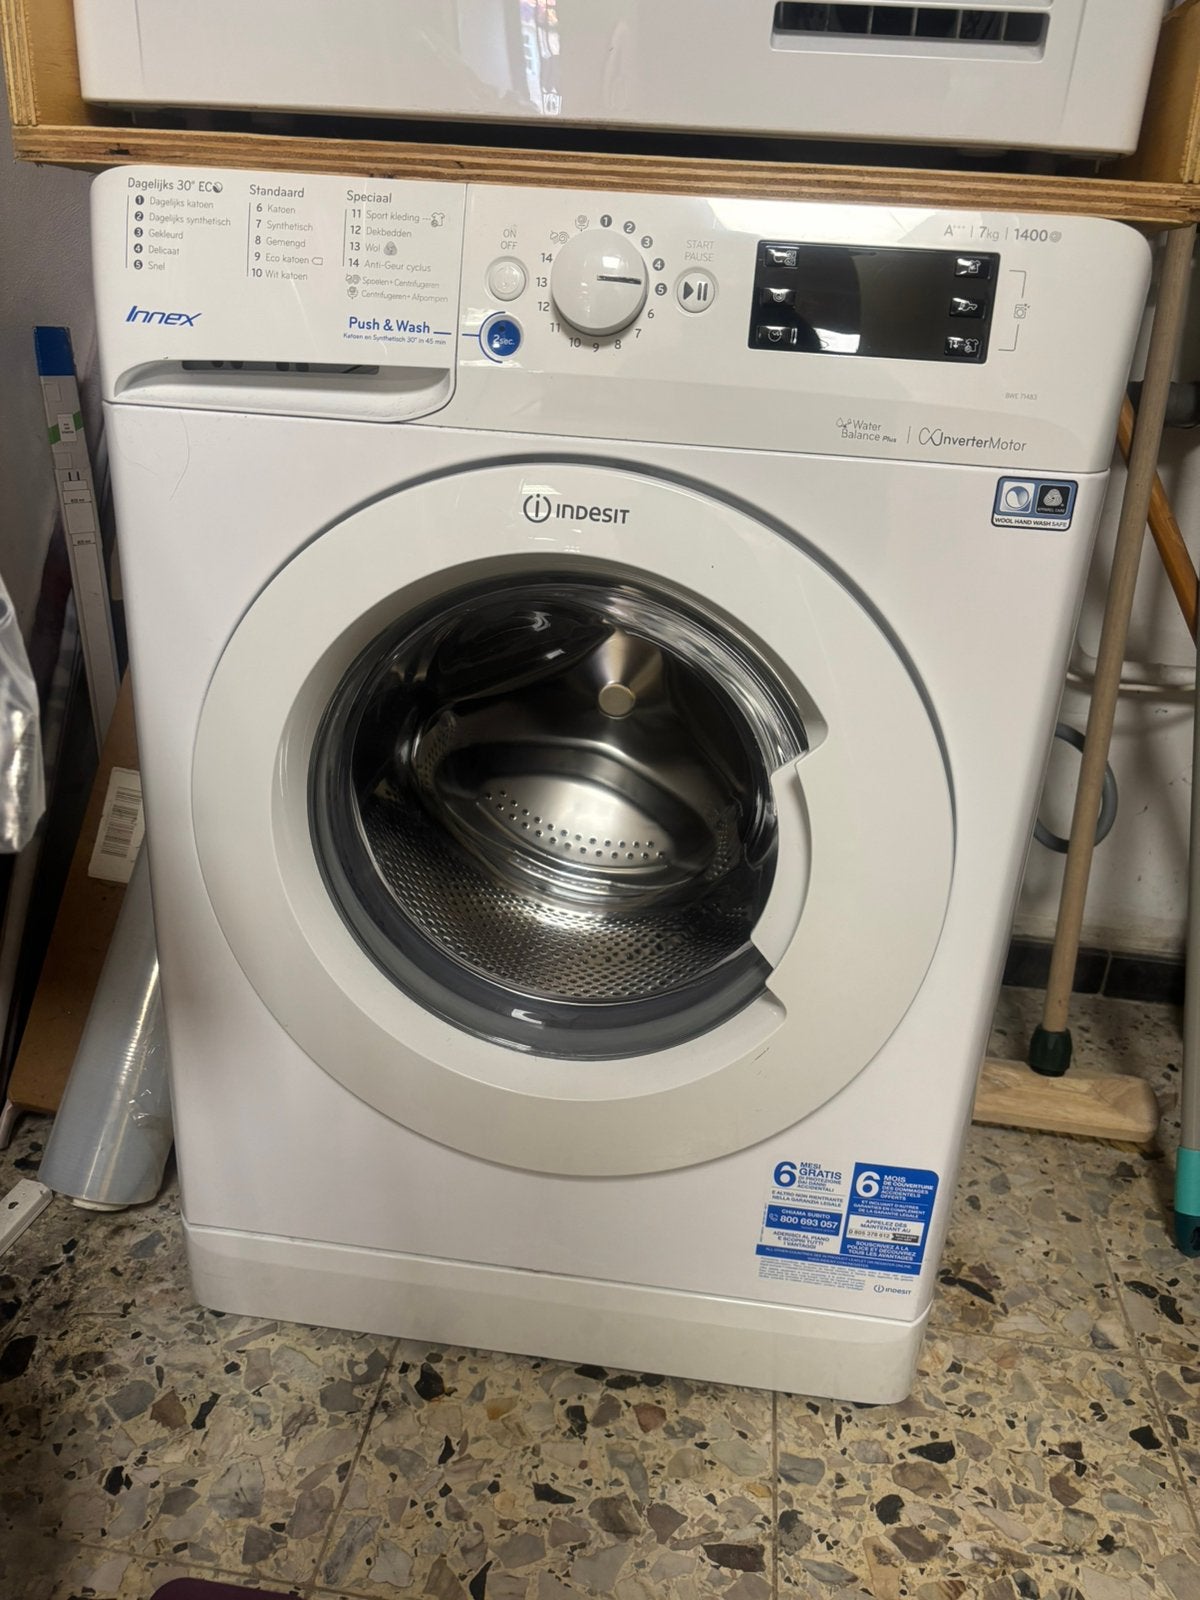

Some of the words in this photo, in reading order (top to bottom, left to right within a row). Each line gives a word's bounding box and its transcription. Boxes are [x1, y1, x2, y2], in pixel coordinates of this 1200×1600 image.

[128, 177, 174, 192] Dagelijks
[176, 180, 195, 191] 30°
[250, 184, 304, 198] Standaard
[150, 196, 185, 208] Dagelijks
[187, 200, 214, 209] katoen
[346, 190, 392, 204] Speciaal
[256, 203, 263, 212] 6
[267, 204, 296, 214] Katoen
[149, 212, 184, 224] Dagelijks
[186, 216, 231, 226] synthetisch
[352, 209, 361, 218] 11
[366, 210, 388, 221] Sport
[390, 212, 420, 223] kleding
[256, 219, 262, 228] 7
[267, 220, 313, 231] Synthetisch
[148, 228, 184, 240] Gekleurd
[351, 226, 361, 235] 12
[366, 226, 412, 238] Dekbedden
[503, 228, 516, 239] ON
[1014, 228, 1048, 242] 1400
[255, 236, 261, 245] 8
[266, 236, 306, 249] Gemengd
[350, 242, 360, 251] 13
[365, 243, 380, 252] Wol
[500, 240, 518, 250] OFF
[686, 240, 714, 250] START
[148, 245, 180, 255] Delicaat
[254, 252, 260, 261] 9
[265, 253, 280, 262] Eco
[282, 254, 309, 264] katoen
[540, 253, 553, 263] 14
[684, 252, 715, 262] PAUSE
[148, 261, 165, 271] Snel
[349, 258, 360, 267] 14
[364, 260, 404, 270] Anti-Geur
[406, 264, 431, 272] cyclus
[252, 268, 262, 278] 10
[265, 270, 279, 279] Wit
[281, 270, 307, 280] katoen
[536, 277, 548, 287] 13
[538, 302, 550, 312] 12
[126, 306, 202, 327] Innex
[648, 309, 654, 319] 6
[349, 316, 379, 330] Push
[383, 319, 393, 331] &
[396, 320, 430, 334] Wash
[550, 322, 561, 333] 11
[635, 329, 641, 338] 7
[569, 338, 581, 348] 10
[592, 342, 599, 352] 9
[614, 340, 621, 350] 8
[852, 420, 882, 431] Water
[841, 429, 880, 442] Balance
[774, 1161, 797, 1187] 6
[799, 1168, 842, 1180] GRATIS
[856, 1171, 880, 1198] 6
[893, 1182, 934, 1190] COUVERTURE
[881, 1190, 921, 1198] ACCIDENTELS
[780, 1215, 799, 1224] 800
[800, 1218, 818, 1226] 693
[820, 1221, 838, 1229] 057
[860, 1224, 900, 1232] MAINTENANT
[856, 1241, 894, 1249] SOUSCRIVEZ
